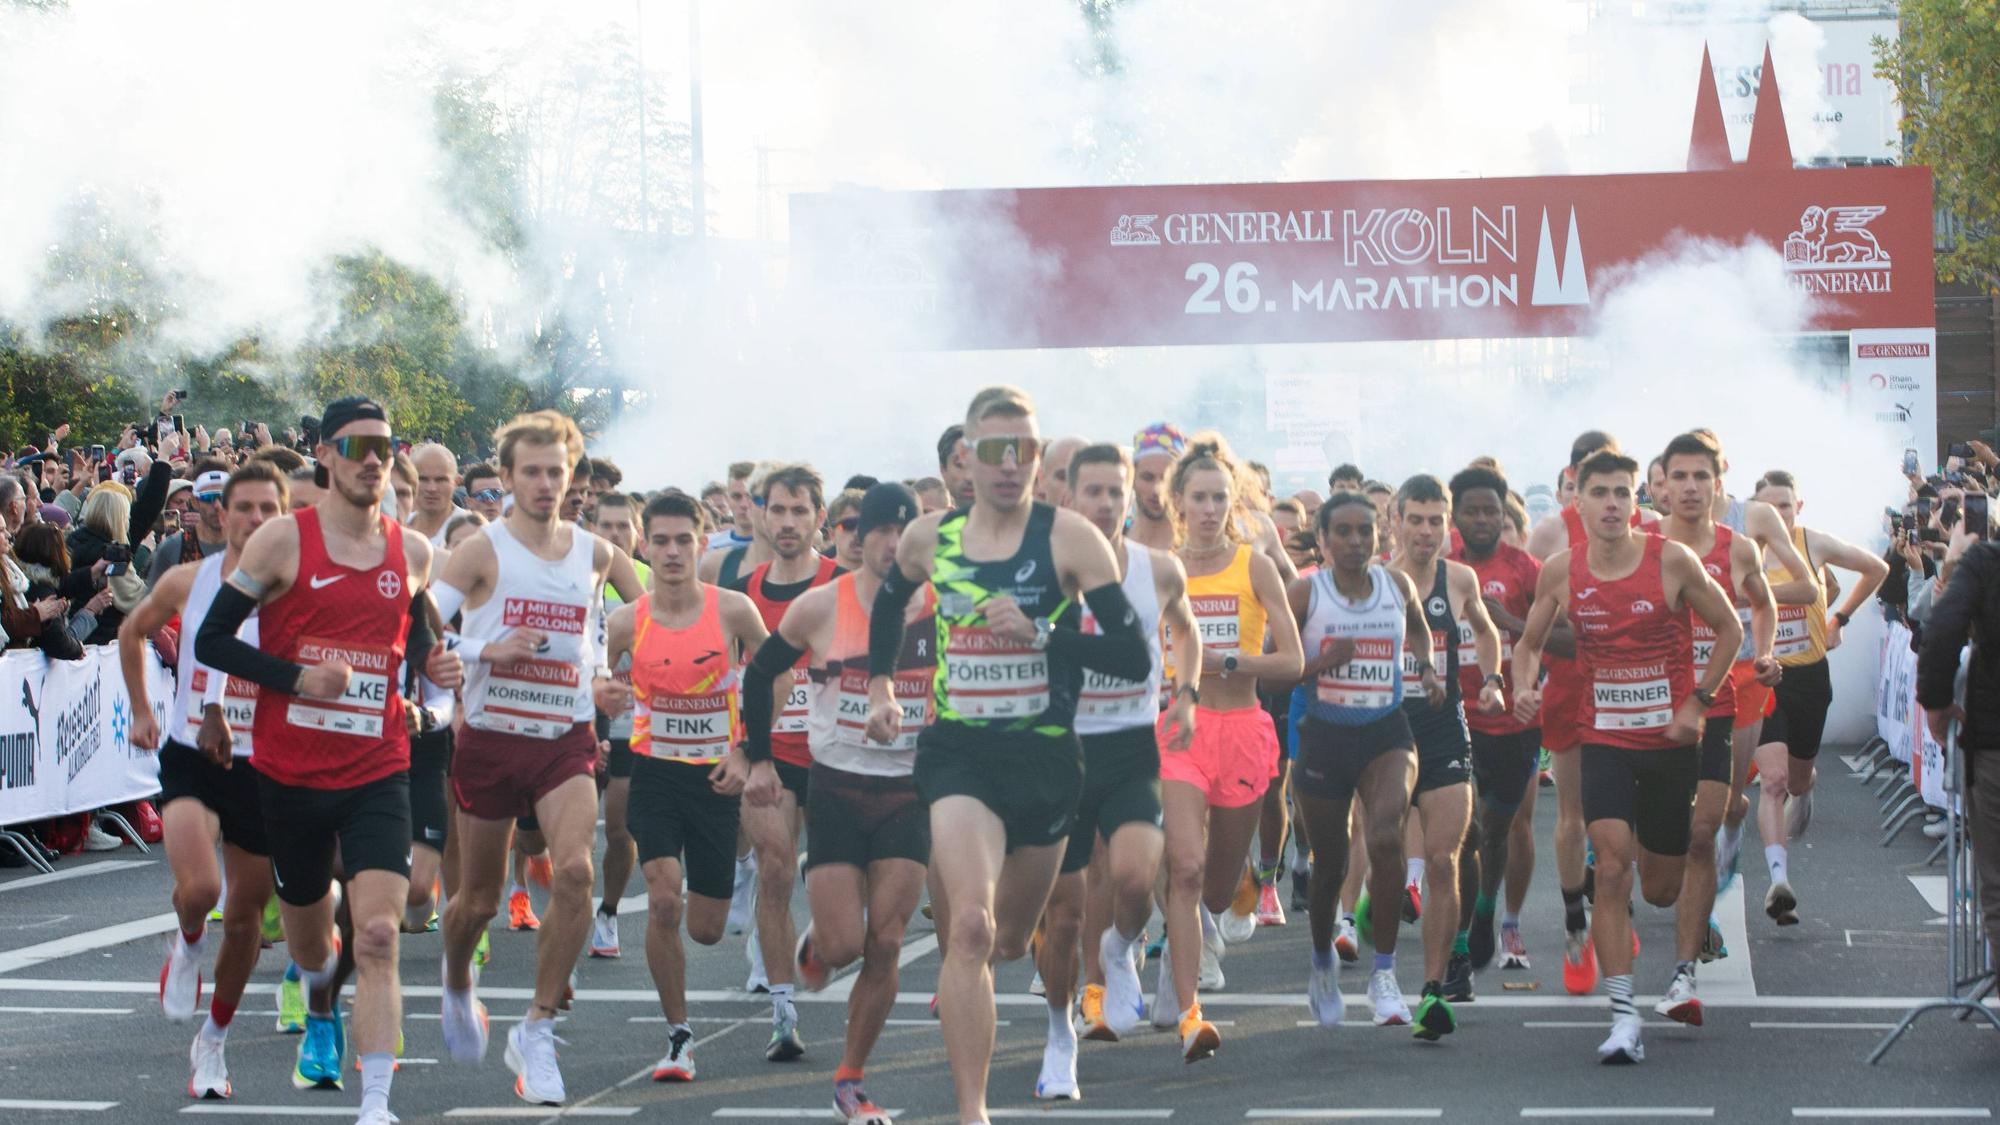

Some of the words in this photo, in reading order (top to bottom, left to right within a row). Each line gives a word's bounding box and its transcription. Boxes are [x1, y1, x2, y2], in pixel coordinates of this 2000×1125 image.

[1164, 210, 1334, 244] GENERALI
[1184, 261, 1277, 314] 26.
[1292, 273, 1519, 312] MARATHON
[1875, 343, 1928, 357] GENERALI
[527, 604, 576, 618] MILERS
[526, 616, 582, 632] COLONIA
[513, 662, 577, 684] GENERALI
[948, 659, 1045, 681] FÖRSTER
[1610, 663, 1665, 680] GENERALI
[346, 680, 386, 701] LKE
[487, 685, 575, 708] KORSMEIER
[1595, 684, 1668, 703] WERNER
[670, 696, 727, 711] GENERALI
[666, 717, 714, 735] FINK
